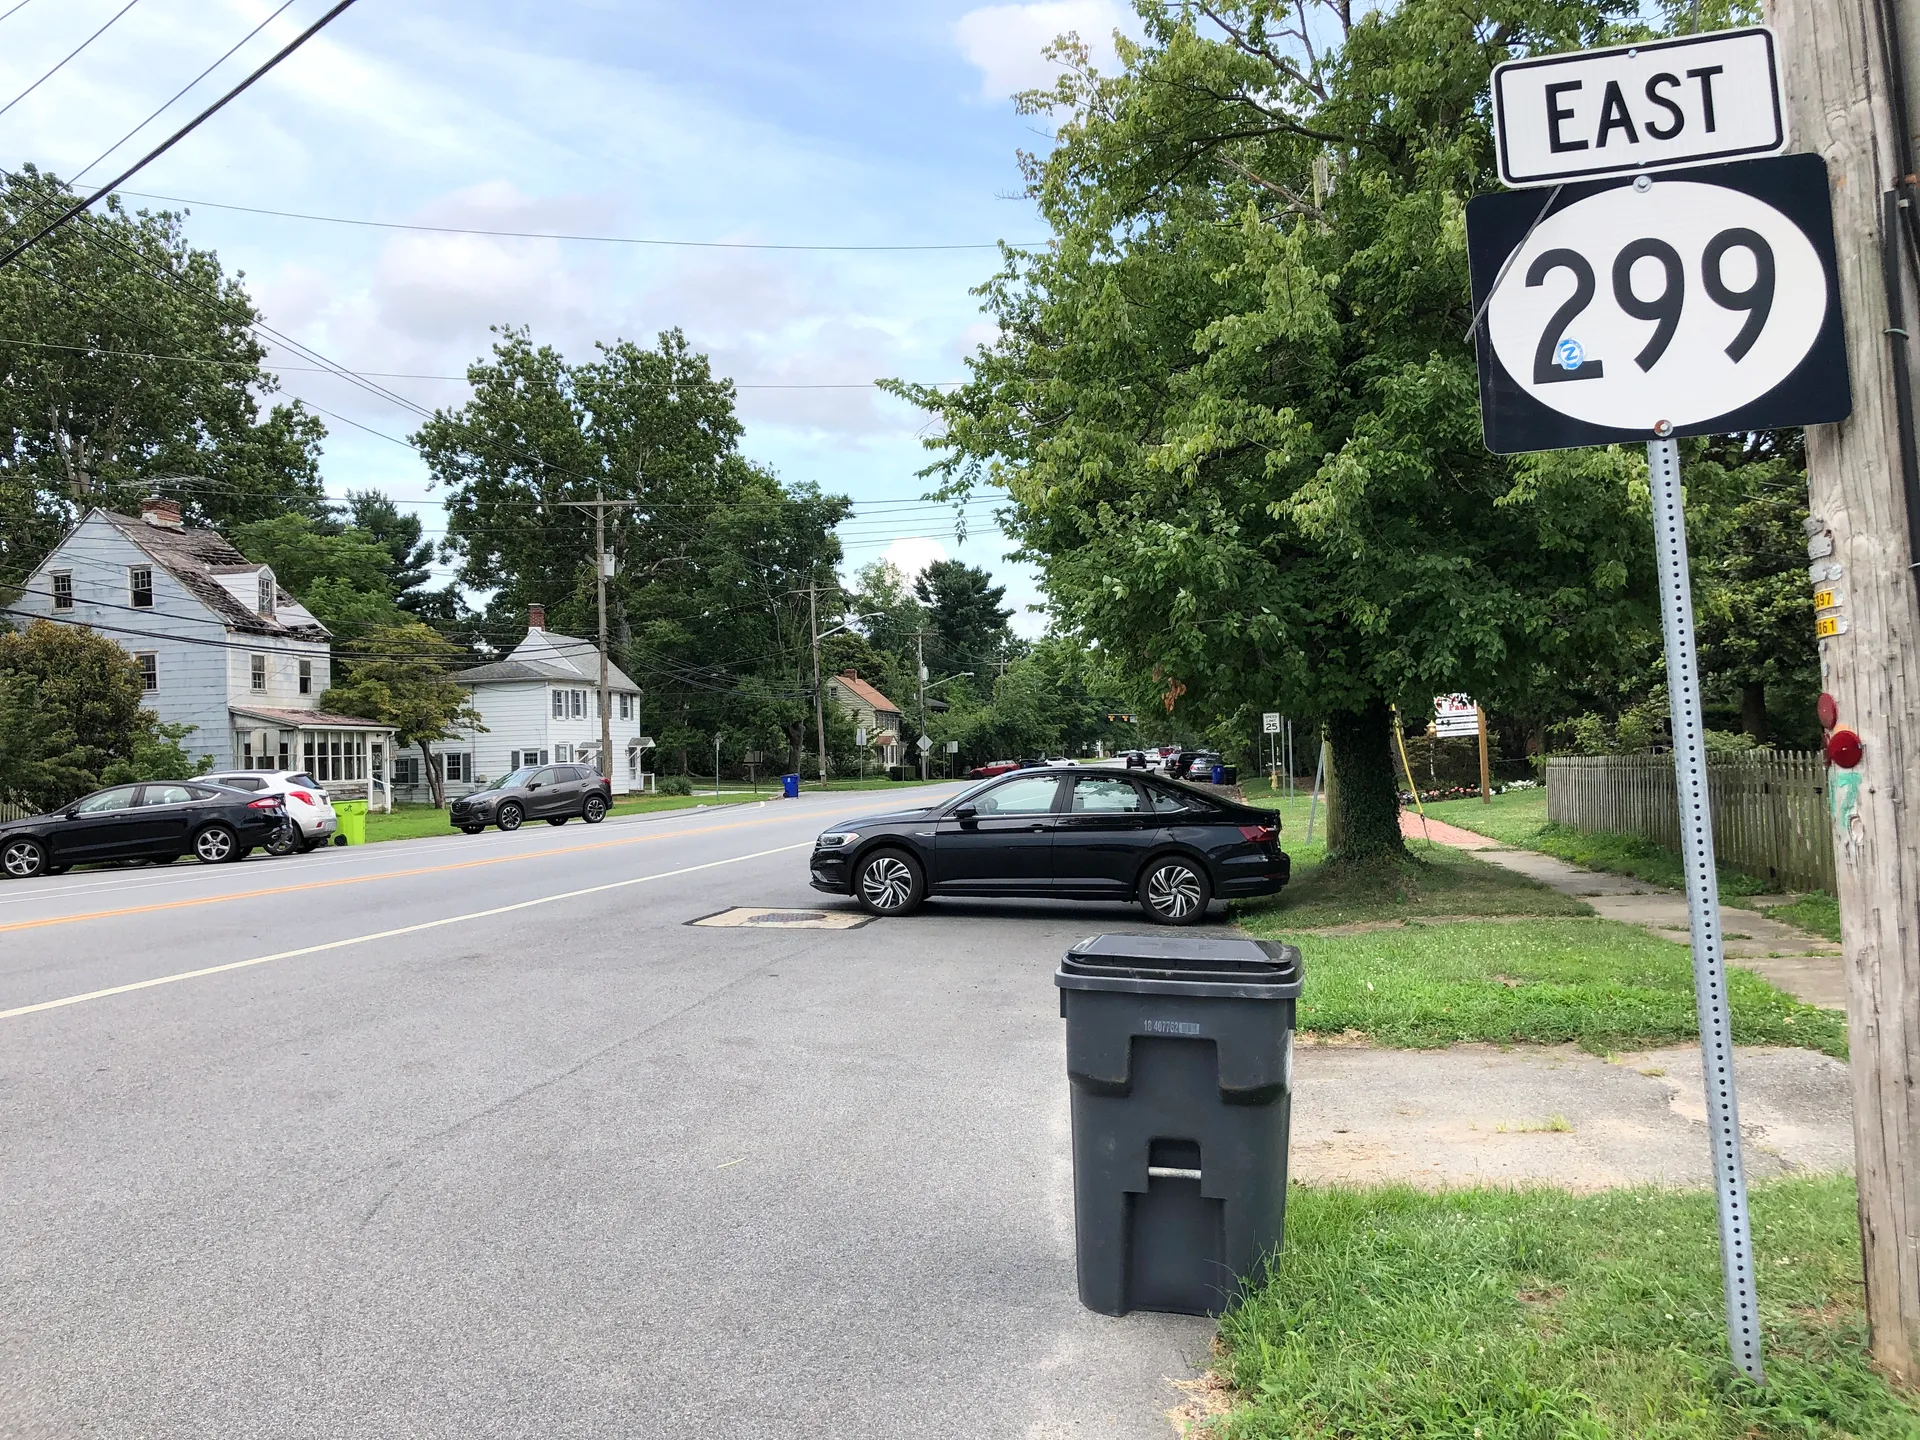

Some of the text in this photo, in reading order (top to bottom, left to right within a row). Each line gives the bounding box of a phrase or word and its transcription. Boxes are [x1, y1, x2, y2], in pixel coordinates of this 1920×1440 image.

[1544, 65, 1724, 154] EAST
[1525, 227, 1775, 385] 299
[1814, 592, 1831, 609] 397
[1449, 703, 1475, 711] Pauls
[1265, 722, 1278, 731] 25
[1143, 1020, 1152, 1032] 18
